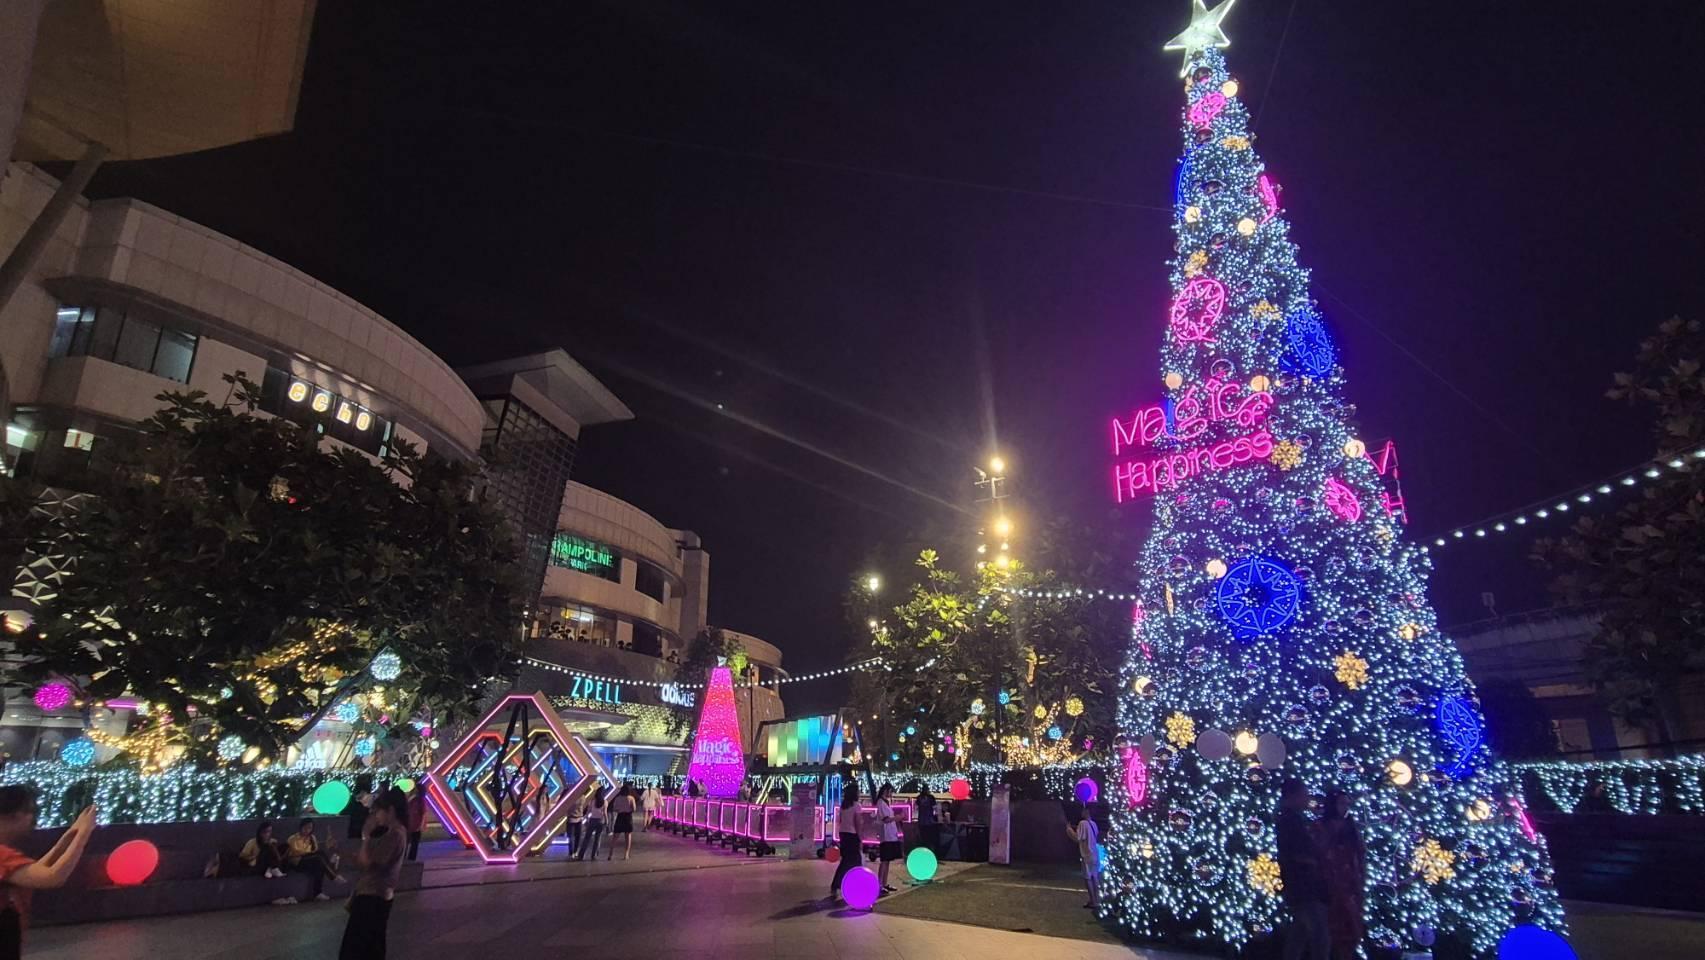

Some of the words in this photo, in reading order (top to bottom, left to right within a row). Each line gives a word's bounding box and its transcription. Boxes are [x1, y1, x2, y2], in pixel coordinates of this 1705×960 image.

[288, 381, 371, 431] echo
[1113, 379, 1273, 457] Magic
[1238, 402, 1269, 426] of
[1115, 432, 1272, 503] Happiness
[570, 676, 622, 703] ZPELL
[661, 682, 696, 708] adidas
